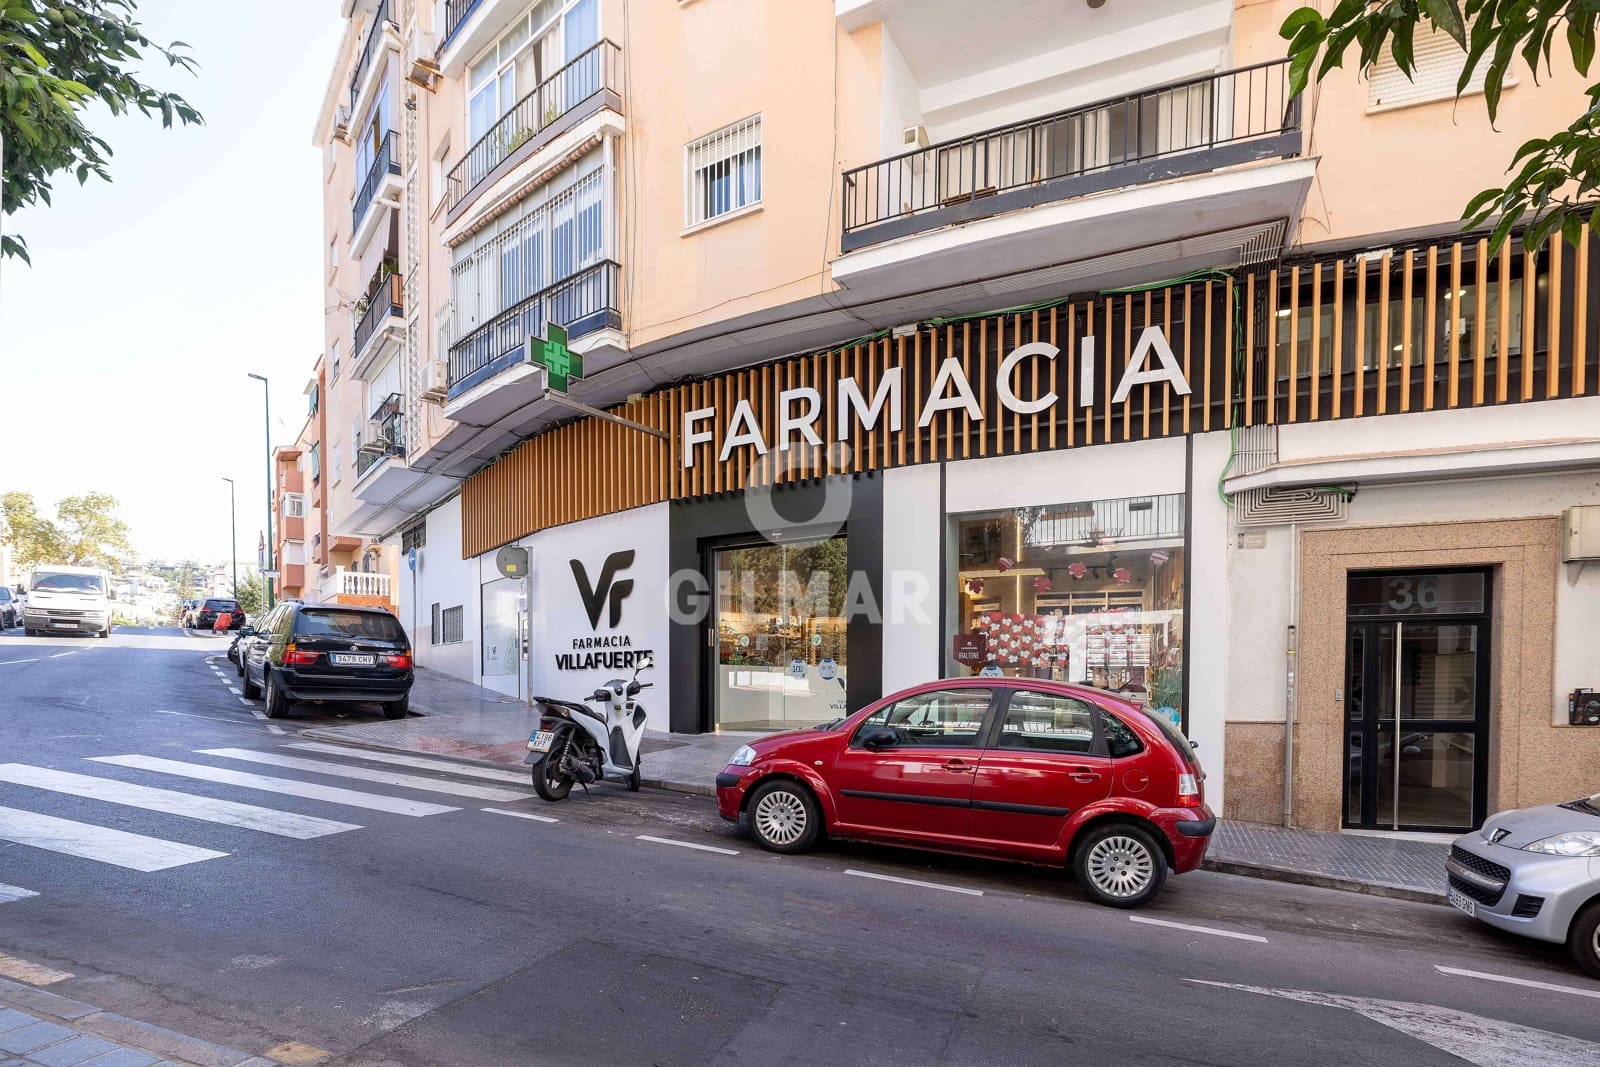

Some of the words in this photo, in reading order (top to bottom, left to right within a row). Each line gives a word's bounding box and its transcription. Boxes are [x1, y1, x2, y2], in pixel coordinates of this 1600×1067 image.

[683, 325, 1193, 468] FARMACIA
[1388, 577, 1441, 610] 36
[572, 635, 631, 649] FARMACIA
[555, 649, 654, 670] VILLAFUERTE
